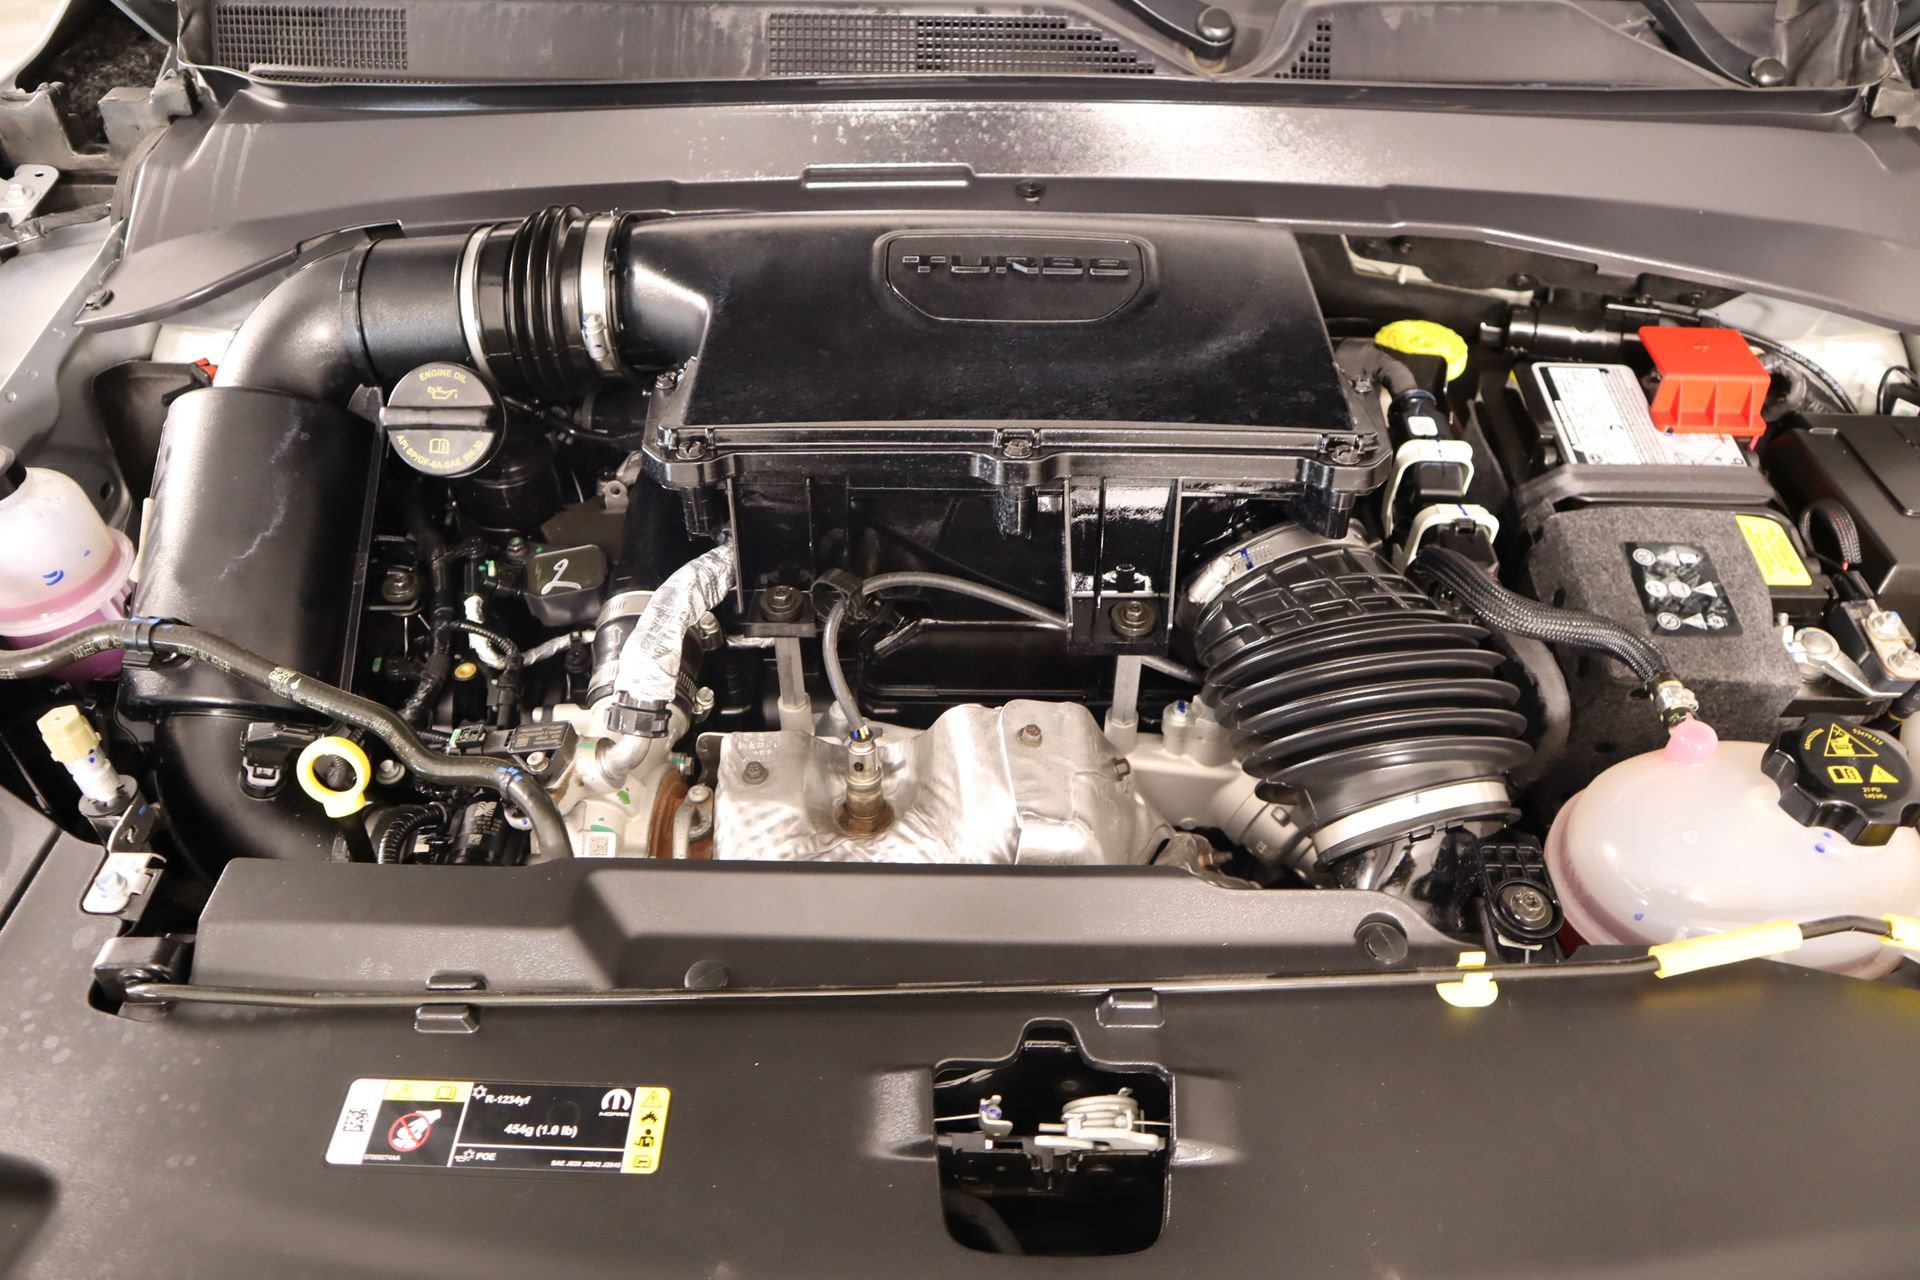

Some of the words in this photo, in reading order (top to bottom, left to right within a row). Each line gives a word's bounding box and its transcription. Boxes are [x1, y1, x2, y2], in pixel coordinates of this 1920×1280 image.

[902, 255, 1131, 278] TURBO
[418, 368, 453, 382] ENGINE
[453, 371, 467, 384] OIL
[396, 435, 409, 450] API
[541, 558, 582, 595] 2
[484, 1094, 532, 1107] R-1234yf
[504, 1123, 534, 1137] 454g
[536, 1124, 559, 1137] (1.0
[560, 1125, 578, 1138] lb)
[475, 1152, 497, 1161] POE
